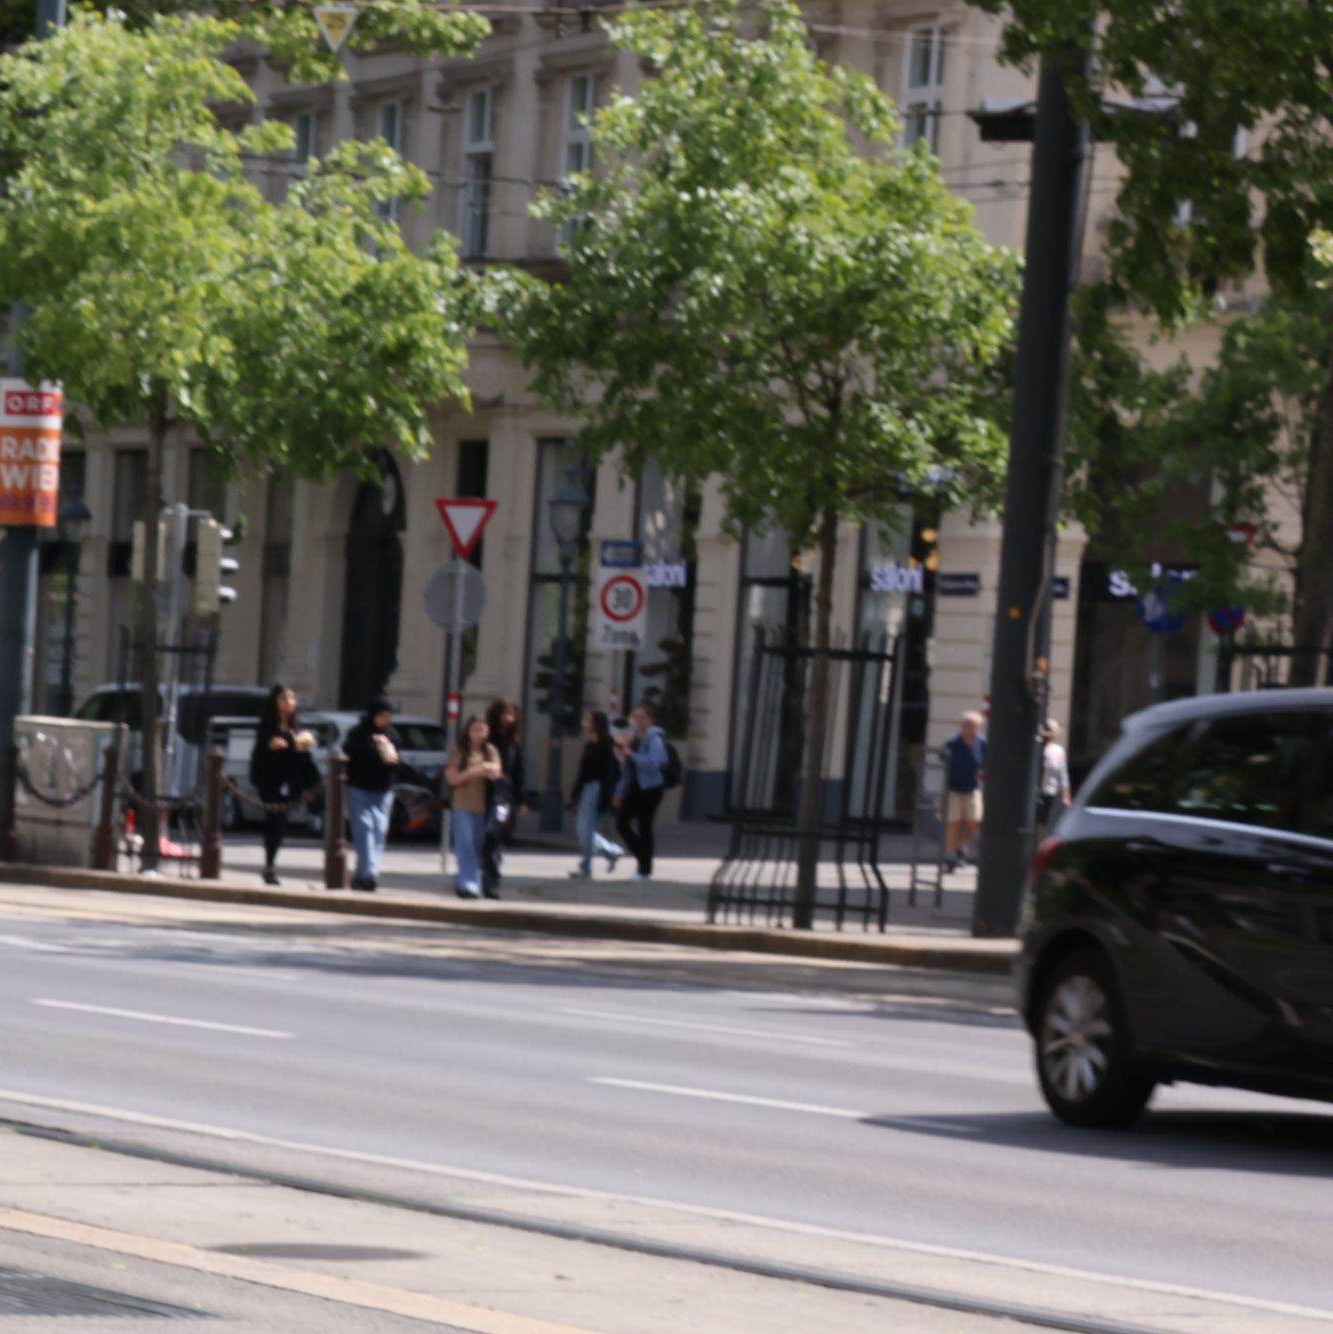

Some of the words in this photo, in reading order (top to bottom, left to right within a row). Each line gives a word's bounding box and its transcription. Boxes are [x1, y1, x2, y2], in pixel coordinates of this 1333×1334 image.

[7, 394, 53, 411] ORF
[1, 436, 60, 461] RADI
[0, 462, 59, 490] WIE
[645, 558, 687, 588] aloni
[612, 587, 633, 610] 30
